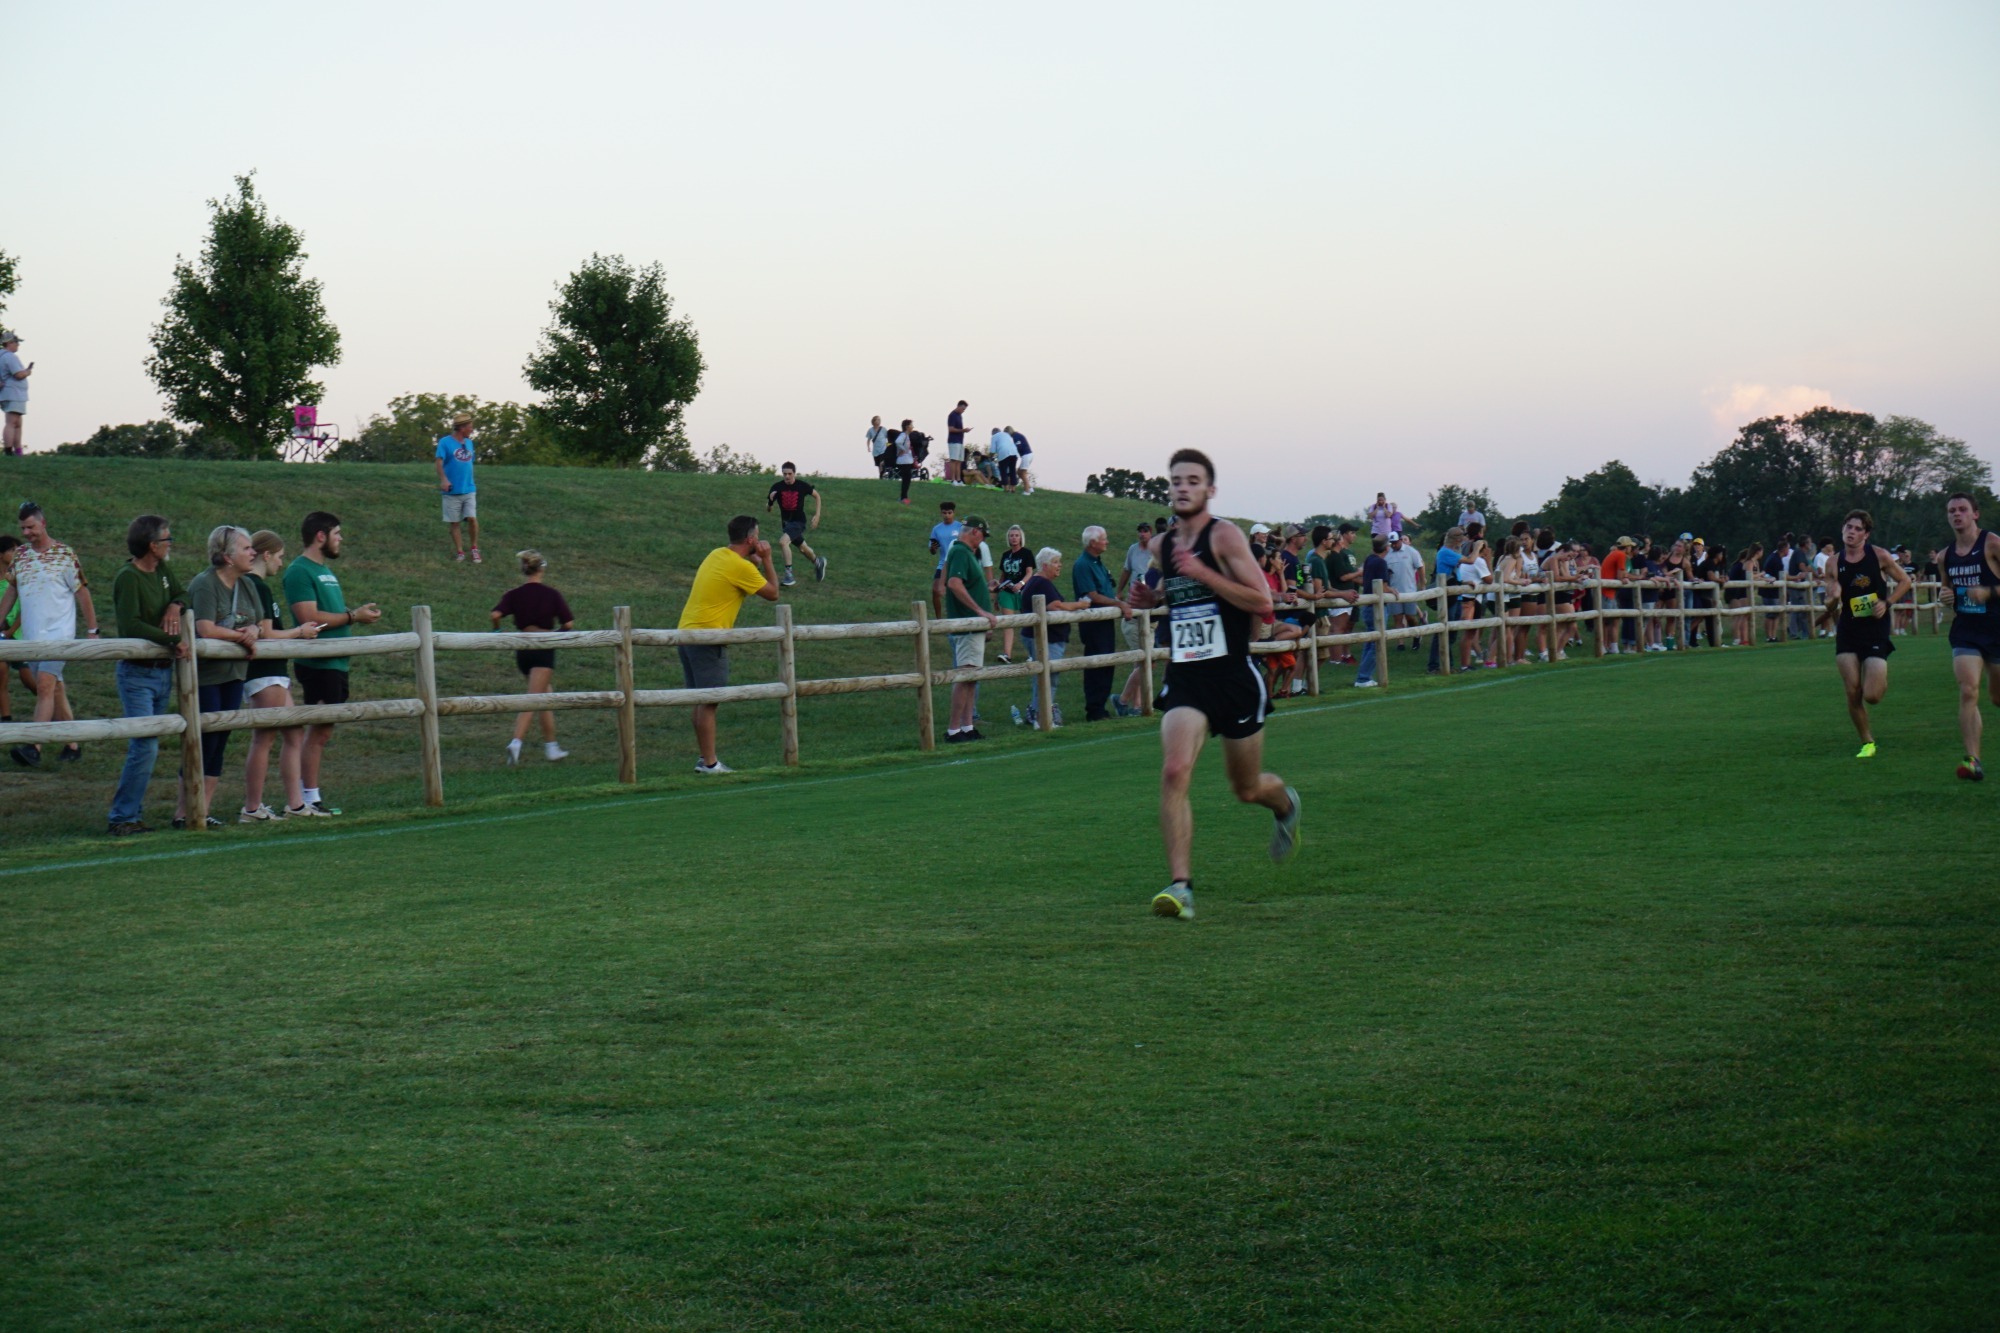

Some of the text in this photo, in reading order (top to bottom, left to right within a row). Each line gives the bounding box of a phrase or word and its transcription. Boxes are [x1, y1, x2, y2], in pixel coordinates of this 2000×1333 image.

[1948, 564, 1981, 577] COLUMBIA
[1952, 576, 1980, 586] COLLEGE
[1853, 600, 1876, 612] 221
[1175, 620, 1215, 648] 2397
